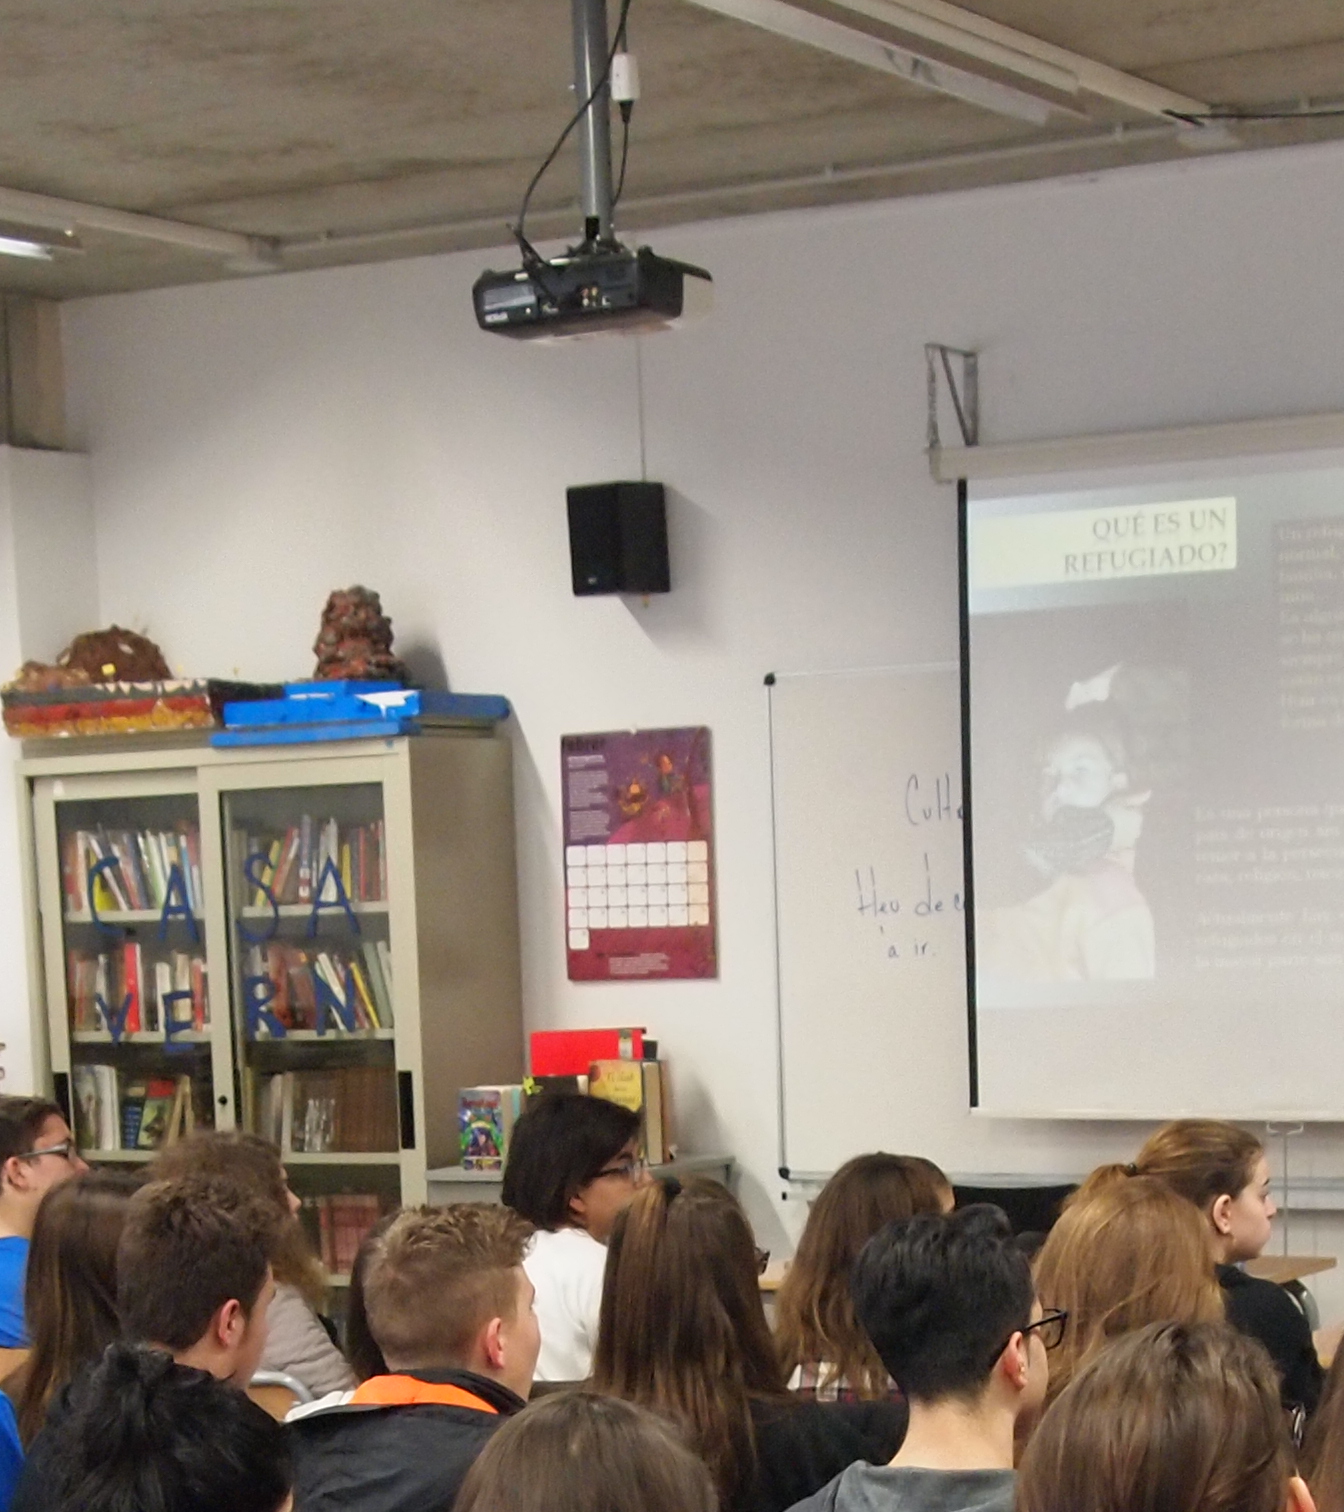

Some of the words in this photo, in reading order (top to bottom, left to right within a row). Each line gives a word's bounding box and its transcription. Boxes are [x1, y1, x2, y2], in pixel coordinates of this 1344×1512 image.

[1092, 509, 1146, 541] QUÉ
[1153, 512, 1181, 533] ES
[1189, 507, 1227, 531] UN
[1064, 543, 1227, 574] REFUGIADO?
[87, 853, 360, 943] CASA
[94, 967, 357, 1053] VERN
